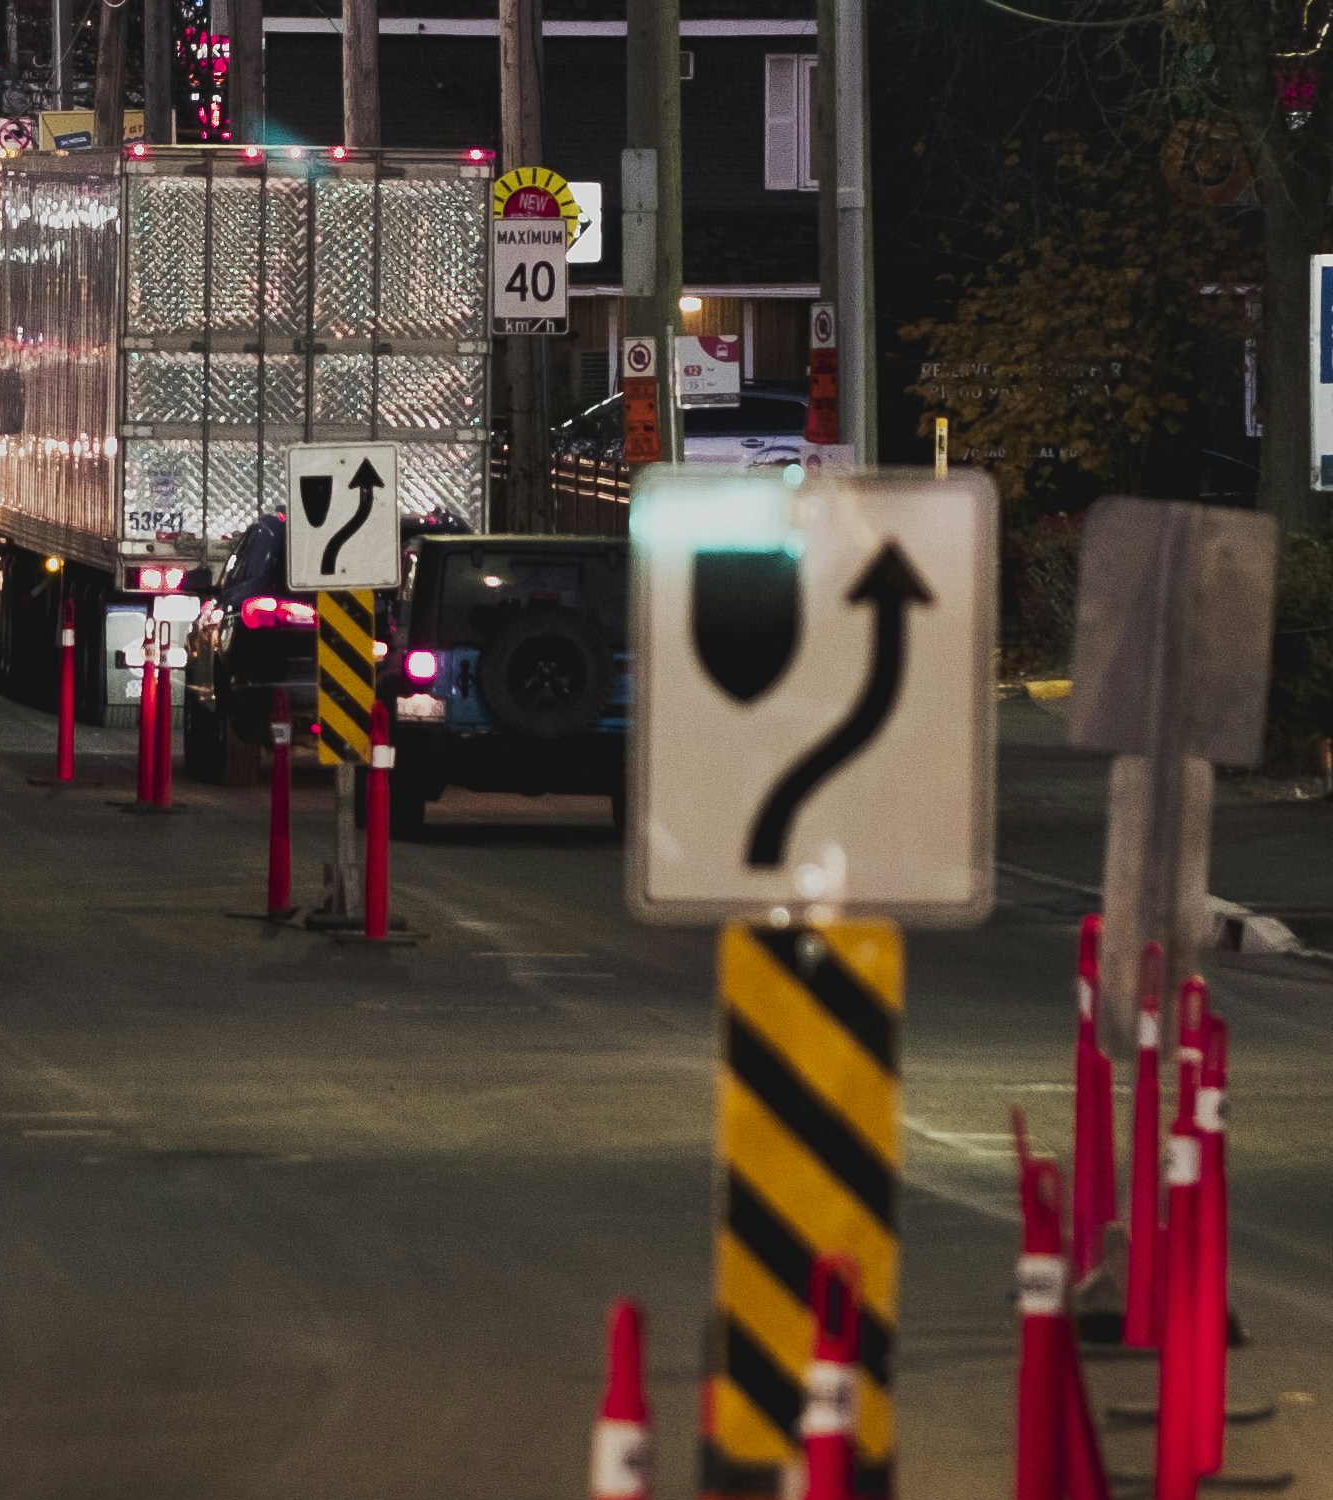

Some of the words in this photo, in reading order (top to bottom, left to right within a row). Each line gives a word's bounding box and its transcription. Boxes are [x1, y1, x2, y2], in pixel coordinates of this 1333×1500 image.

[518, 193, 549, 212] NEW
[497, 230, 563, 245] MAXIMUM
[504, 260, 556, 303] 40
[504, 318, 556, 333] km/h
